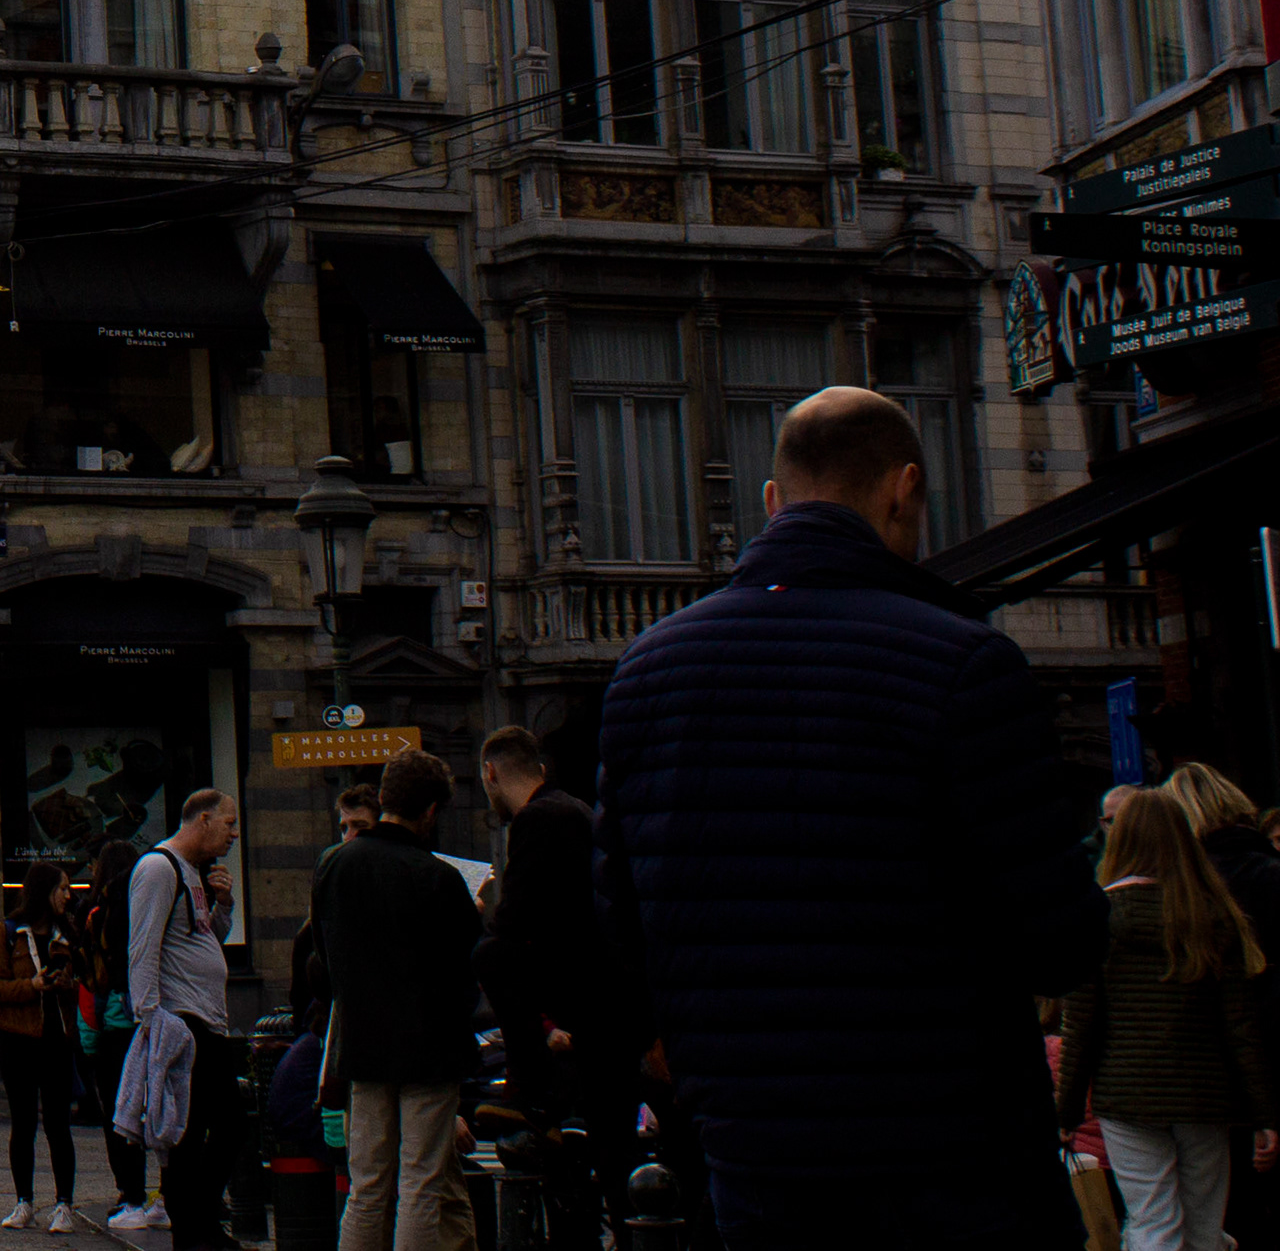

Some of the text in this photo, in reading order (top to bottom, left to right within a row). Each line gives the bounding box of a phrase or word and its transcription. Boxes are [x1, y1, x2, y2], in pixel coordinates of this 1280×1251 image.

[1123, 146, 1221, 183] Palais de Justice
[1136, 166, 1212, 197] Justitiepaleis
[1142, 221, 1238, 239] Place Royale
[1141, 239, 1243, 257] Koningsplein
[1111, 297, 1246, 337] Musée Juif de Belgique
[98, 327, 195, 339] PIERRE MARCOLINI
[383, 334, 476, 344] PIERRE MARCOLINI
[1110, 311, 1250, 356] Joods Museum van België
[80, 645, 176, 655] PIERRE MARCOLINI
[301, 734, 390, 746] MAROLLES
[302, 749, 390, 760] MAROLLEN
[41, 846, 51, 856] du
